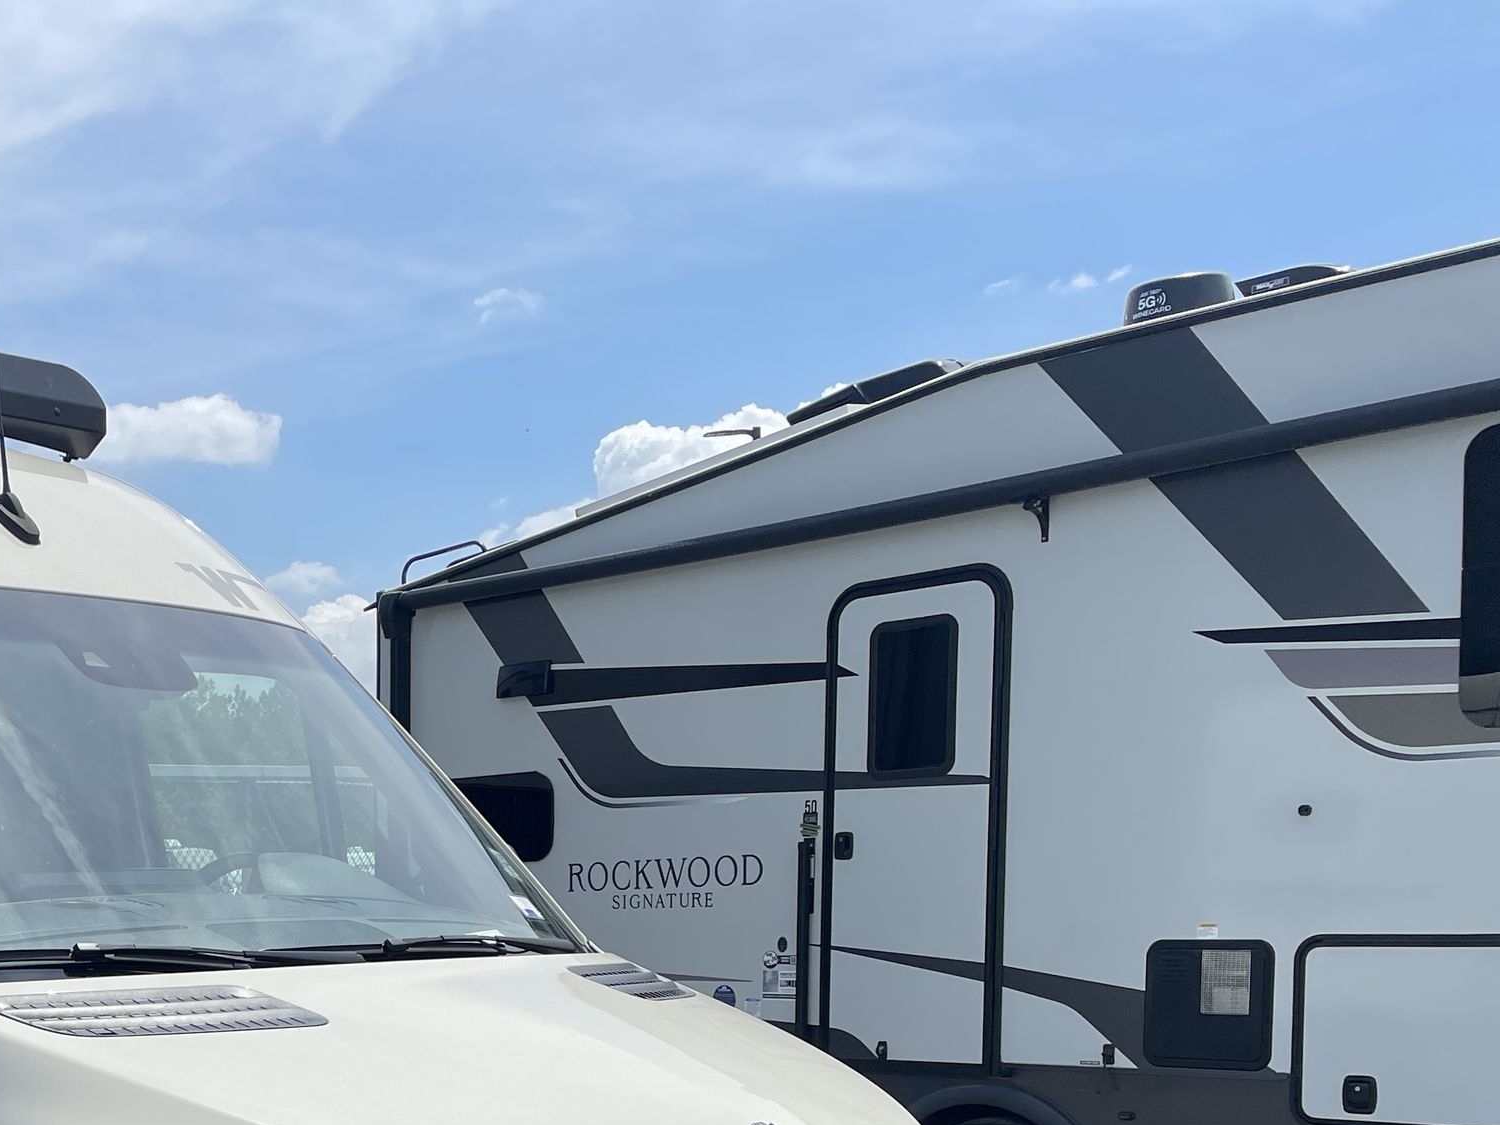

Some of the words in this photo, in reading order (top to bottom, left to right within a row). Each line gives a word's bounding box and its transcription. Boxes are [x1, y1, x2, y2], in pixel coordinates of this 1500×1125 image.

[1138, 295, 1156, 311] 5G
[804, 800, 817, 813] 50
[568, 854, 764, 892] ROCKWOOD
[611, 891, 714, 910] SIGNATURE
